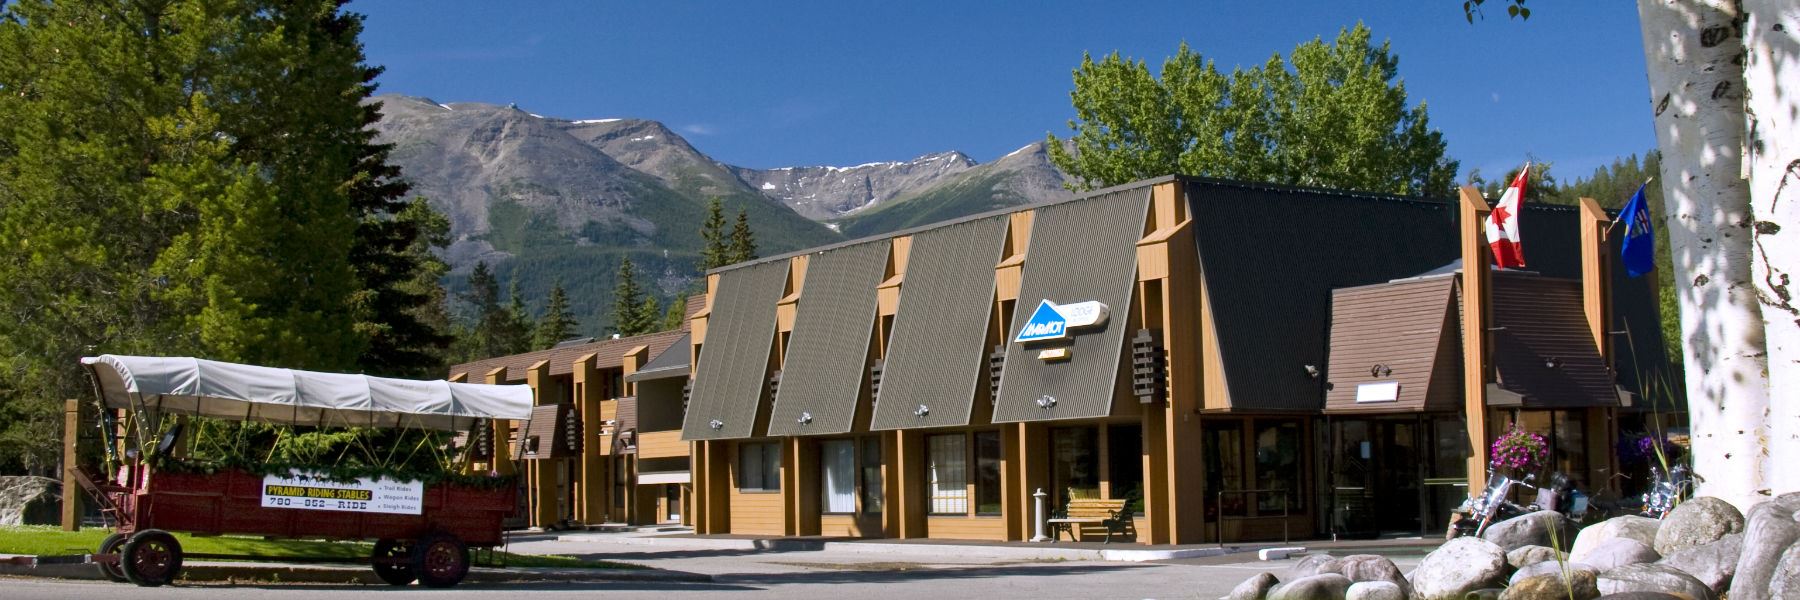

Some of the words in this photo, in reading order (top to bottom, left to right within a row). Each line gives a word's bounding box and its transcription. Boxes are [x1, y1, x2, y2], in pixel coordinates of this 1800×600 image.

[268, 486, 305, 496] PYRAMID
[307, 488, 335, 498] RIDING
[337, 490, 369, 500] STABLES
